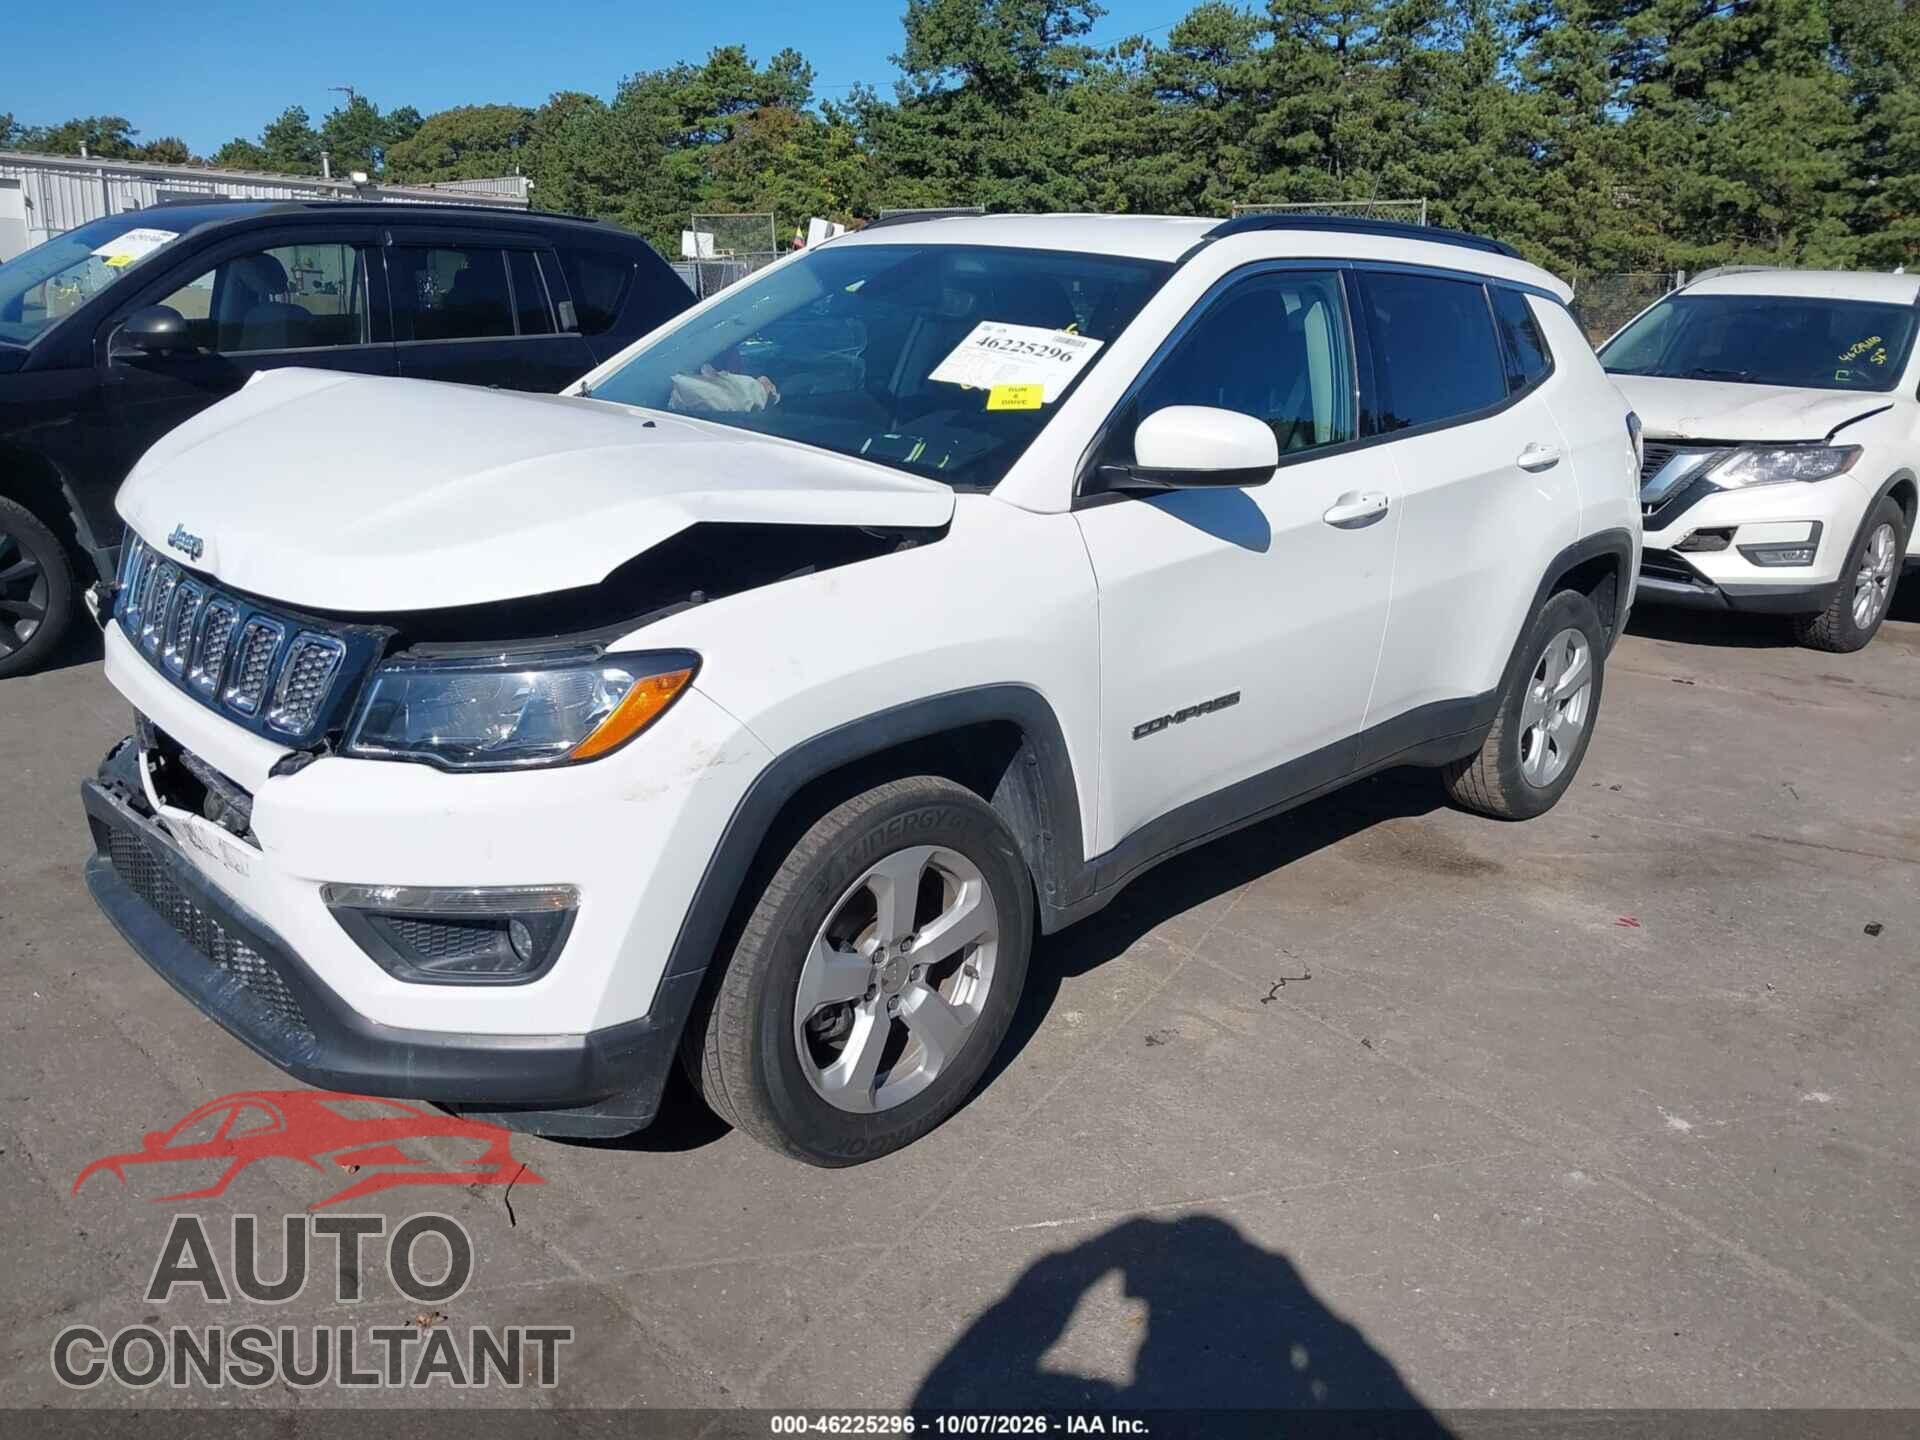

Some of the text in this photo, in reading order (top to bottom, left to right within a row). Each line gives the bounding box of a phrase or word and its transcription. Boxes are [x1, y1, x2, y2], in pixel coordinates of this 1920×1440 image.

[976, 335, 1073, 363] 46225296
[167, 523, 204, 562] Jeep
[1132, 690, 1241, 741] COMPASS
